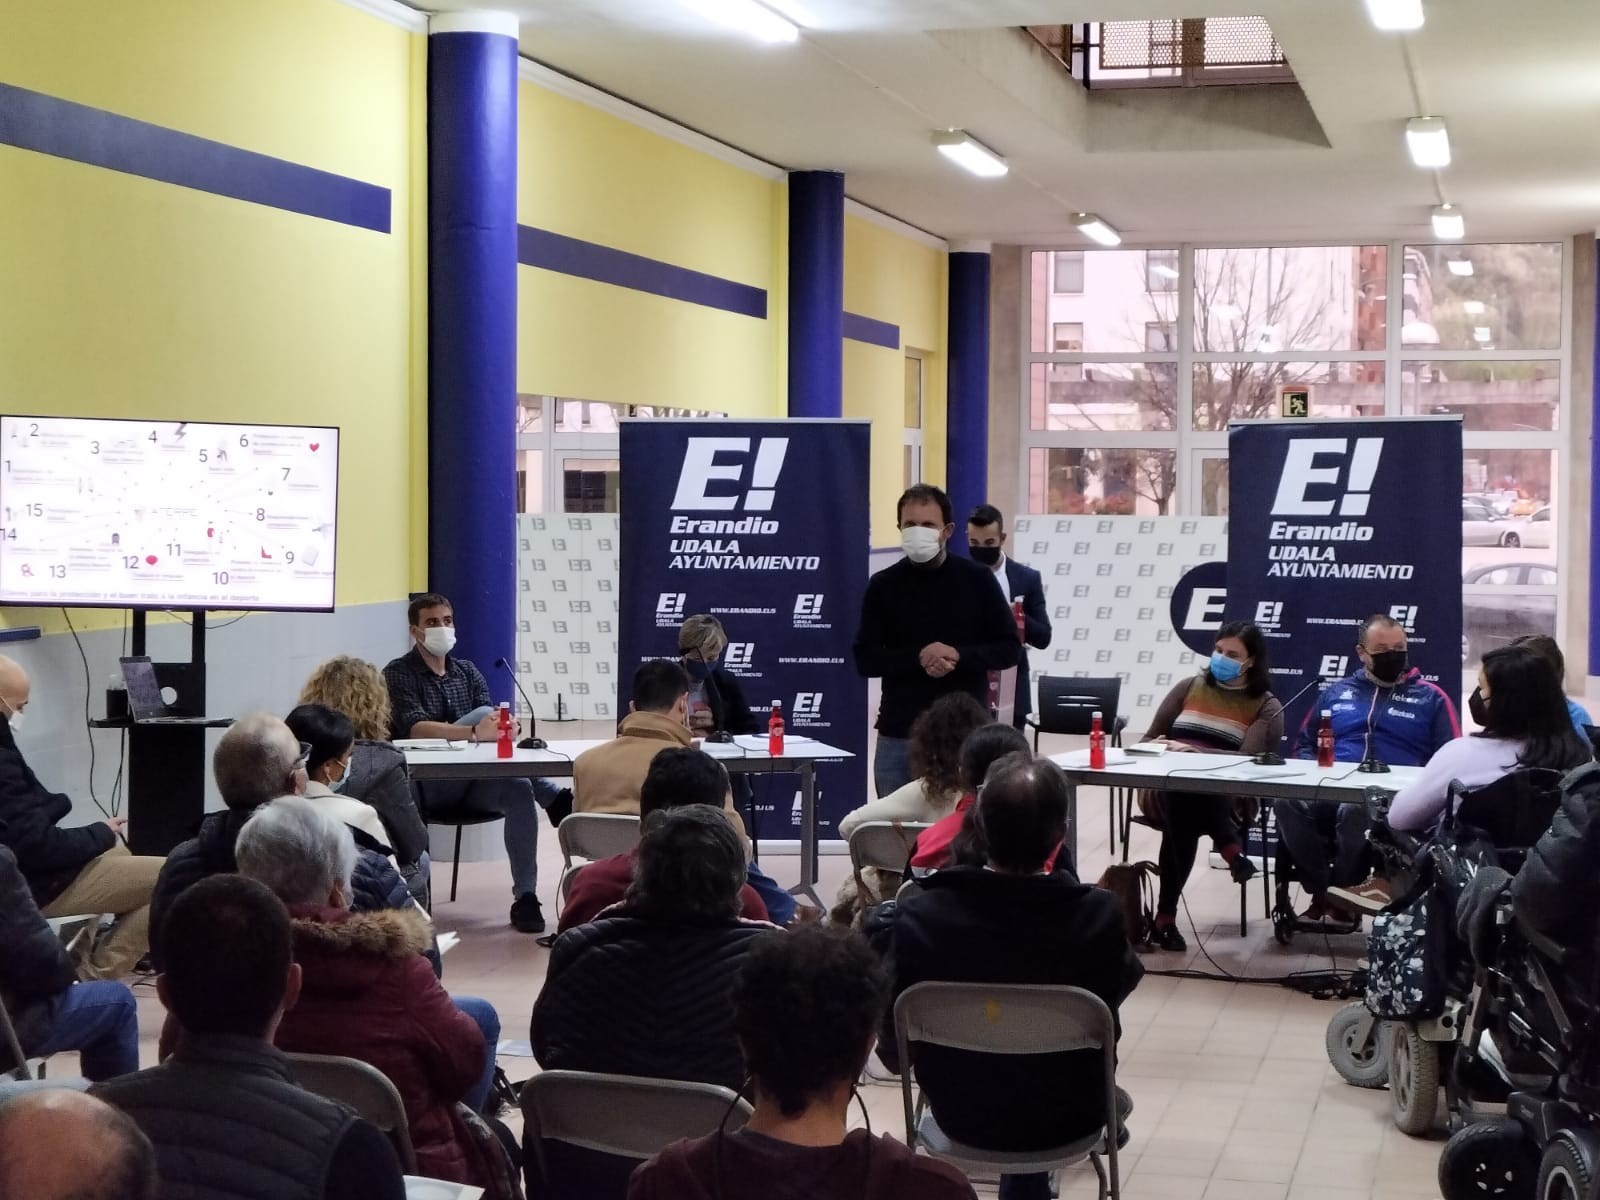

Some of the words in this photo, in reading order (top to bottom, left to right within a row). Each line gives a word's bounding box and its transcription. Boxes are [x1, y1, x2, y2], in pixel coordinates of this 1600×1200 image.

[30, 423, 39, 437] 2
[148, 430, 158, 443] 4
[91, 441, 100, 454] 3
[239, 434, 249, 448] 6
[199, 448, 208, 463] 5
[4, 459, 11, 473] 1
[670, 437, 789, 510] E!
[281, 467, 291, 481] 7
[1270, 437, 1384, 516] E!
[25, 503, 43, 517] 15
[256, 507, 265, 522] 8
[670, 516, 779, 534] Erandio
[1269, 521, 1374, 541] Erandio
[0, 527, 17, 541] 14
[166, 543, 181, 556] 11
[670, 540, 740, 553] UDALA
[1268, 546, 1335, 561] UDALA
[122, 555, 139, 570] 12
[285, 551, 295, 565] 9
[668, 555, 820, 570] AYUNTAMIENTO
[49, 564, 66, 579] 13
[212, 571, 229, 585] 10
[1266, 562, 1414, 580] AYUNTAMIENTO
[656, 593, 686, 612] E!
[793, 594, 824, 614] E!
[1254, 601, 1284, 622] E!
[724, 642, 755, 662] E!
[1319, 655, 1349, 677] E!
[792, 693, 823, 712] E!
